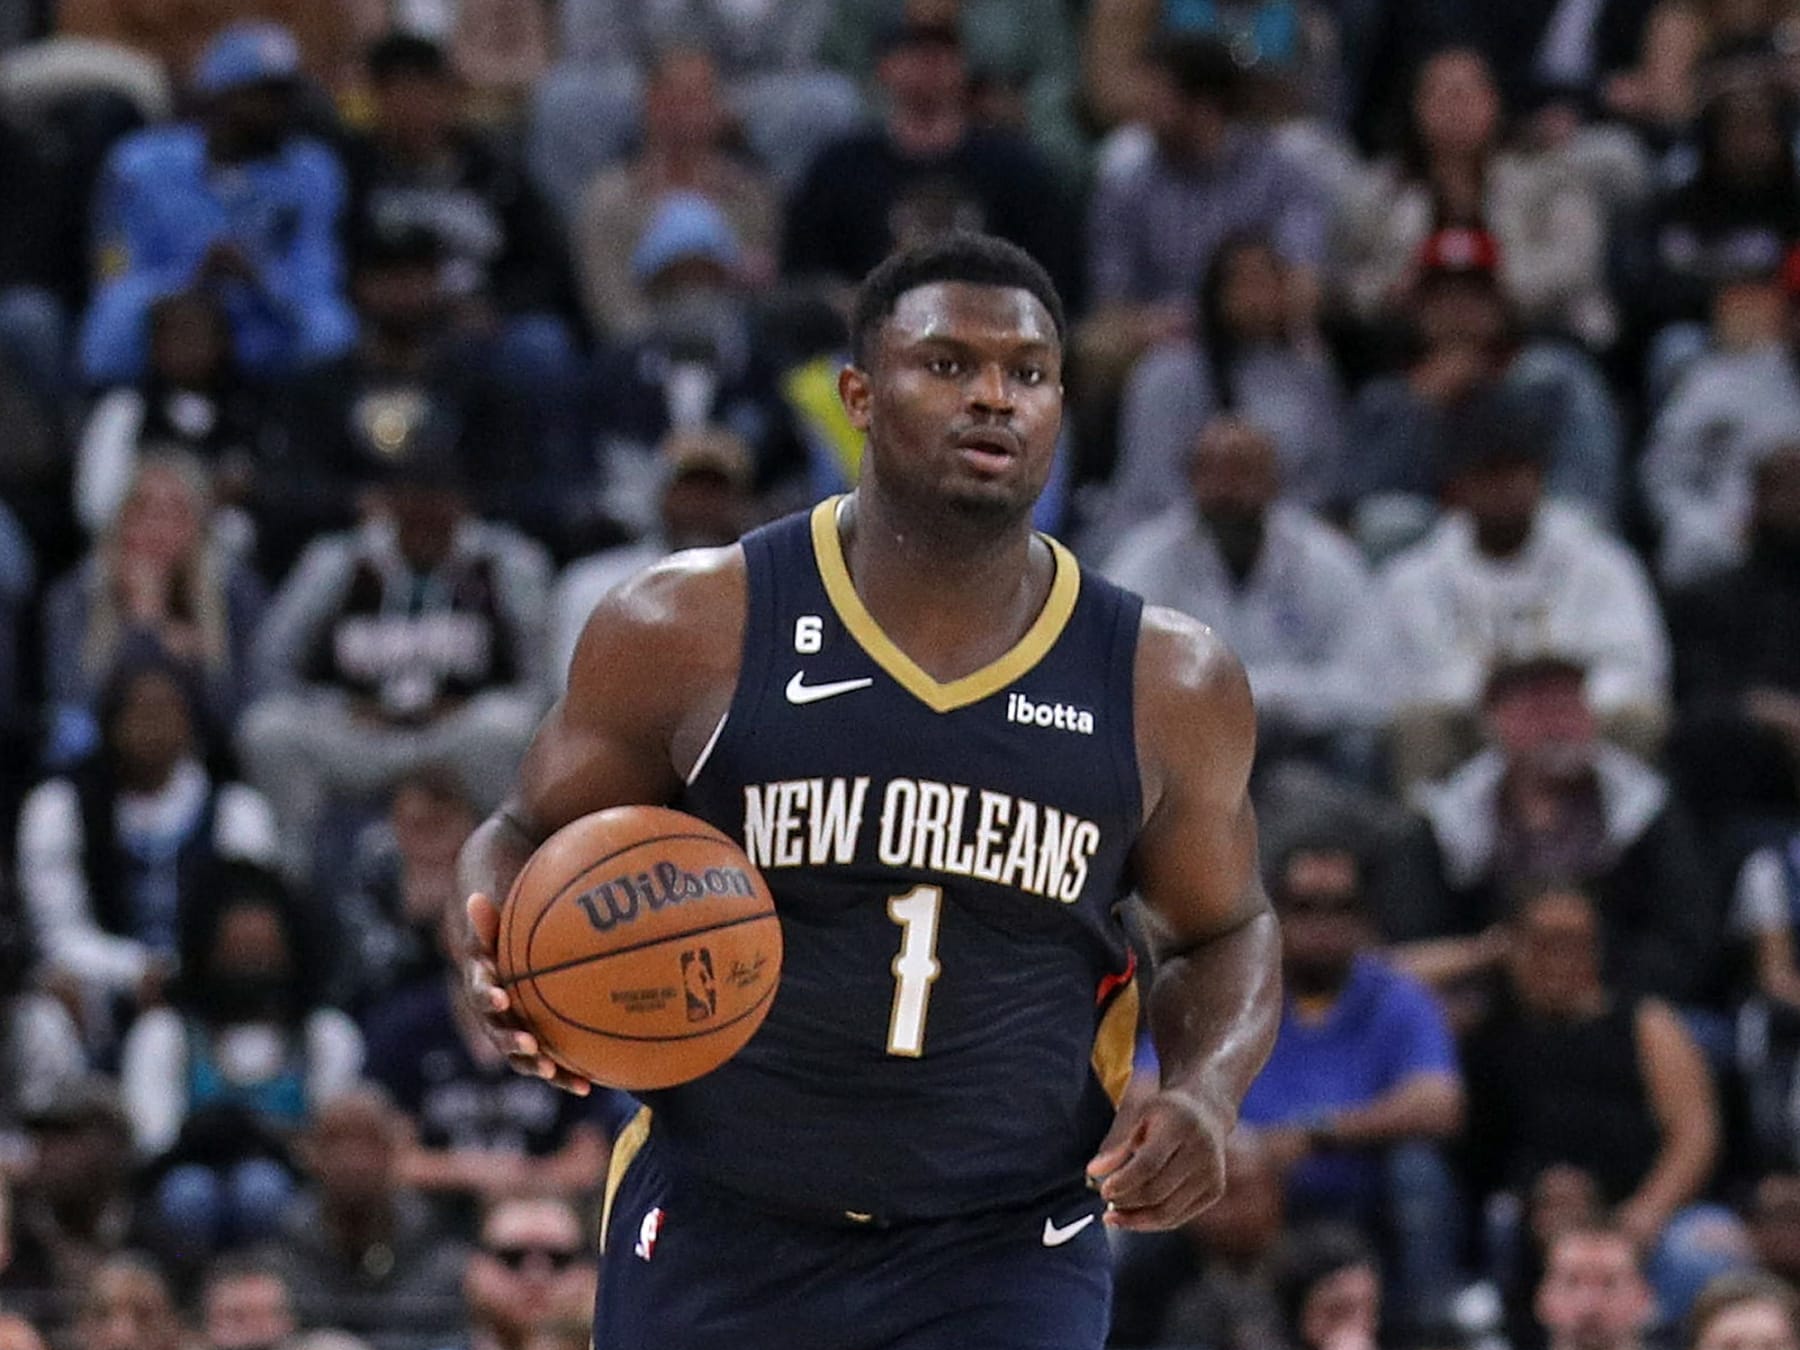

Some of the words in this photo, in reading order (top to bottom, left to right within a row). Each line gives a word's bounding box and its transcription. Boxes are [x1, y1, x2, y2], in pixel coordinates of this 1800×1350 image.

[795, 615, 823, 655] 6
[1007, 692, 1094, 735] ibotta
[743, 775, 870, 868] NEW
[878, 776, 1100, 903] ORLEANS
[576, 861, 757, 933] Wilson
[886, 883, 943, 1058] 1
